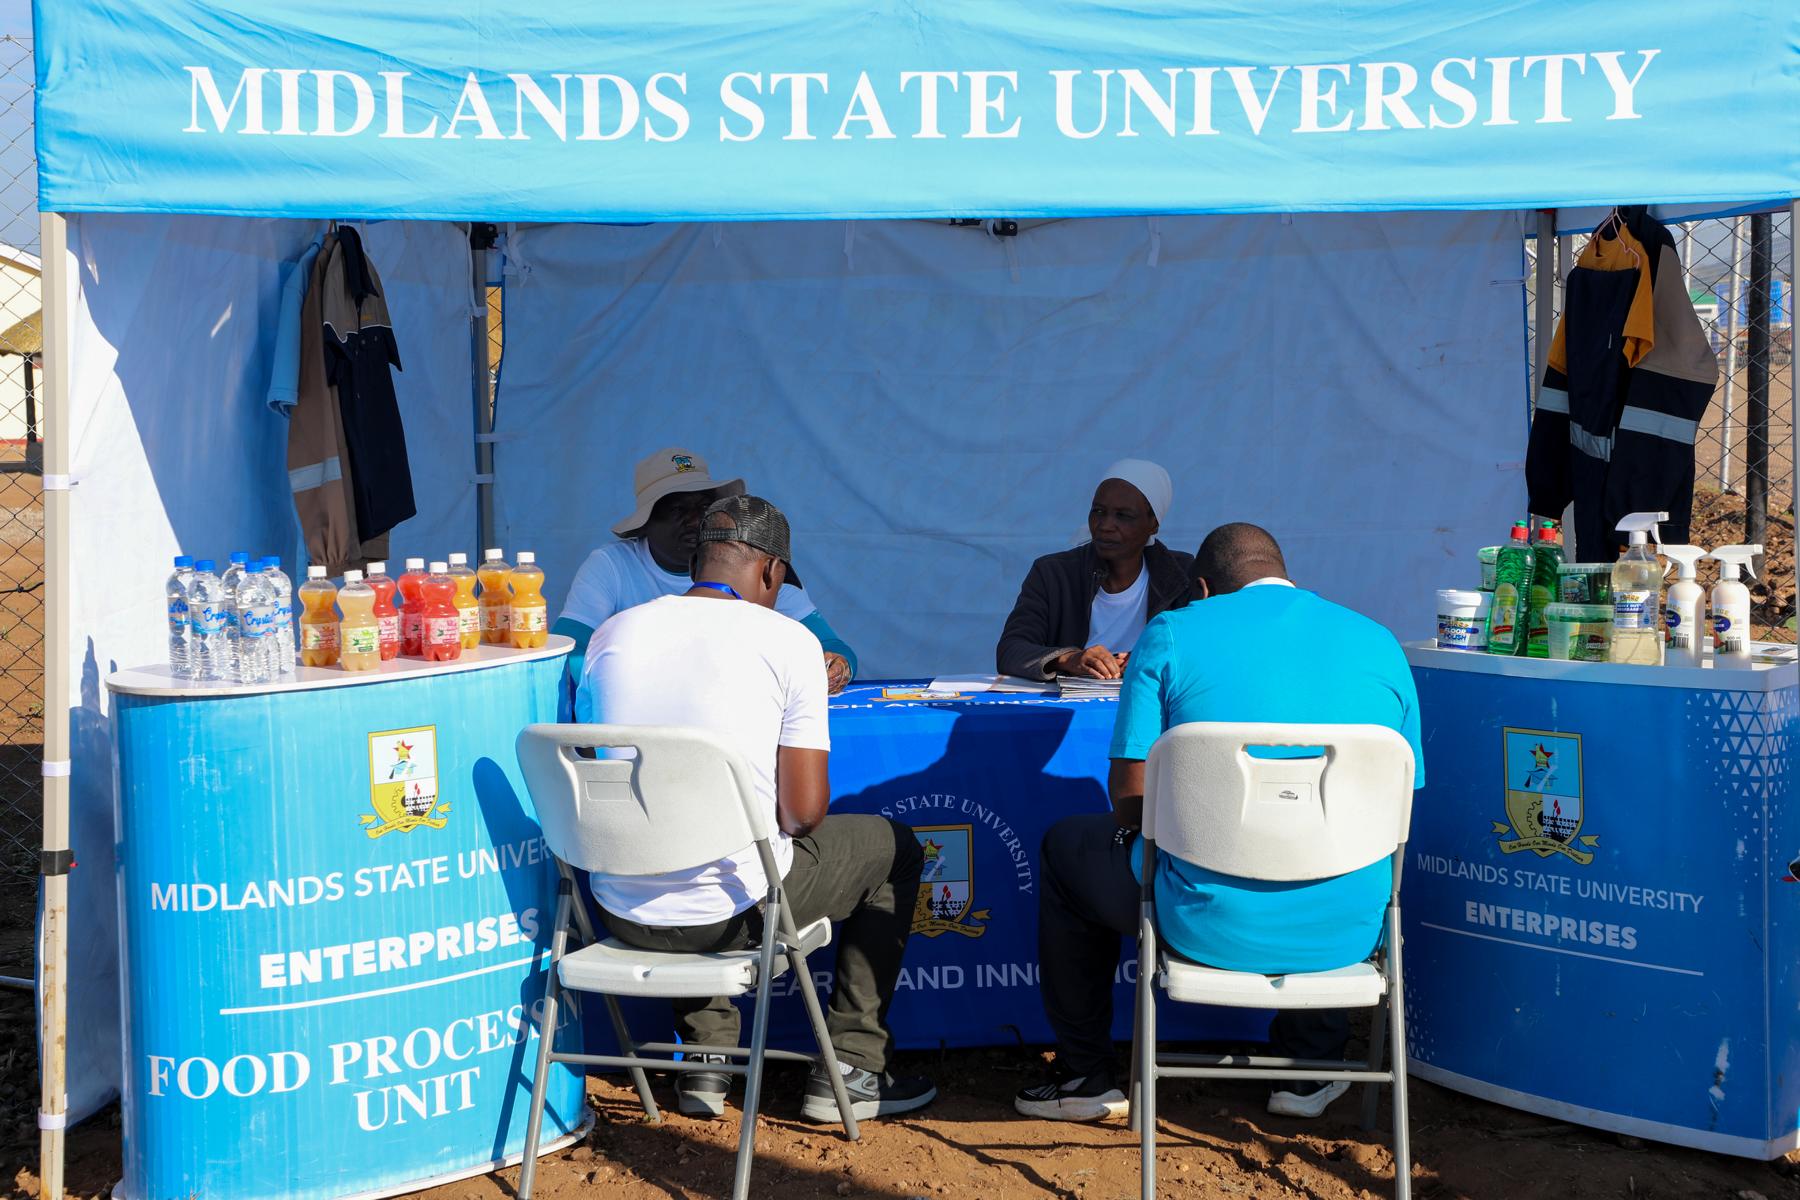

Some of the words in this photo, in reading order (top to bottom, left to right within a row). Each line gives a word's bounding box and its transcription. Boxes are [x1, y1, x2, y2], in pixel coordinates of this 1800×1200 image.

[182, 66, 690, 142] MIDLANDS
[719, 71, 1022, 142] STATE
[1049, 49, 1661, 139] UNIVERSITY
[151, 871, 345, 912] MIDLANDS
[354, 855, 450, 897] STATE
[457, 835, 552, 879] UNIVER
[896, 794, 956, 814] STATE
[961, 798, 1032, 894] UNIVERSITY
[1417, 853, 1509, 886] MIDLANDS
[1514, 870, 1571, 896] STATE
[1577, 879, 1704, 913] UNIVERSITY
[259, 908, 540, 990] ENTERPRISES
[1464, 901, 1637, 950] ENTERPRISES
[894, 965, 964, 991] AND
[147, 1050, 311, 1099] FOOD
[353, 1066, 481, 1132] UNIT
